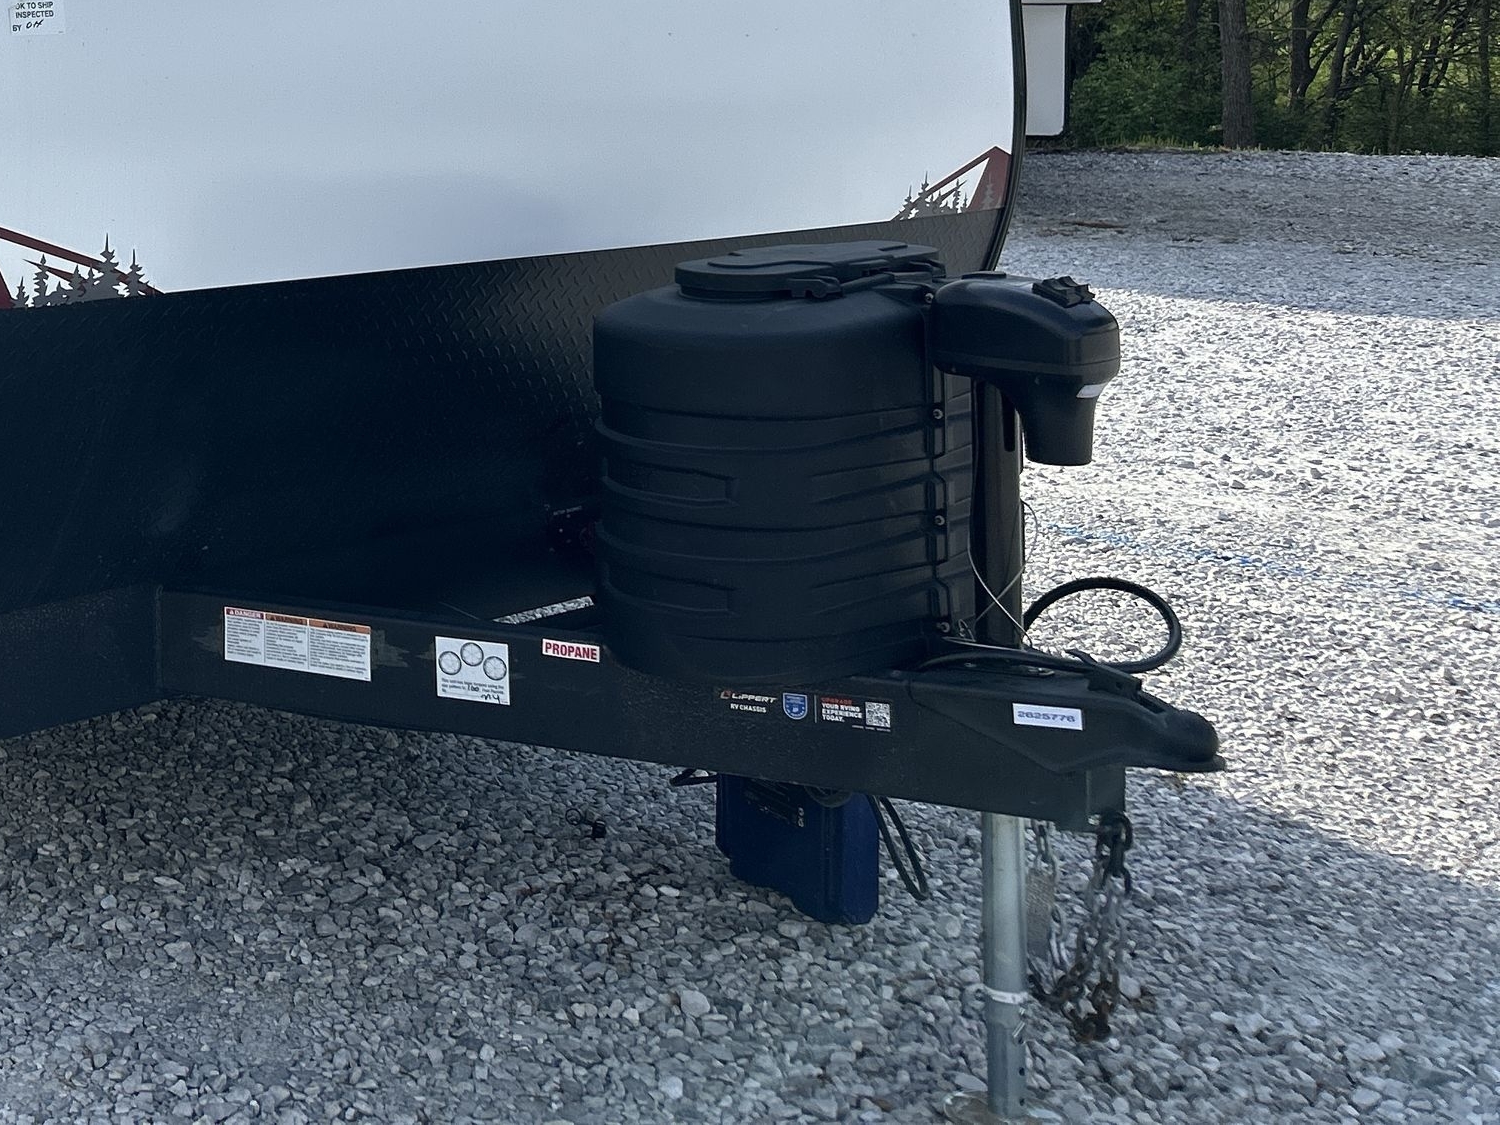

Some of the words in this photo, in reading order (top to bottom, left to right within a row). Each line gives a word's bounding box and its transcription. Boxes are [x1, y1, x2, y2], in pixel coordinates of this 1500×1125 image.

[15, 2, 25, 10] OK
[37, 1, 54, 9] SHIP
[15, 10, 54, 19] INSPECTED
[12, 24, 22, 32] BY
[544, 641, 598, 661] PROPANE
[739, 704, 767, 713] CHASSIS
[821, 708, 863, 719] EXPERIENCE
